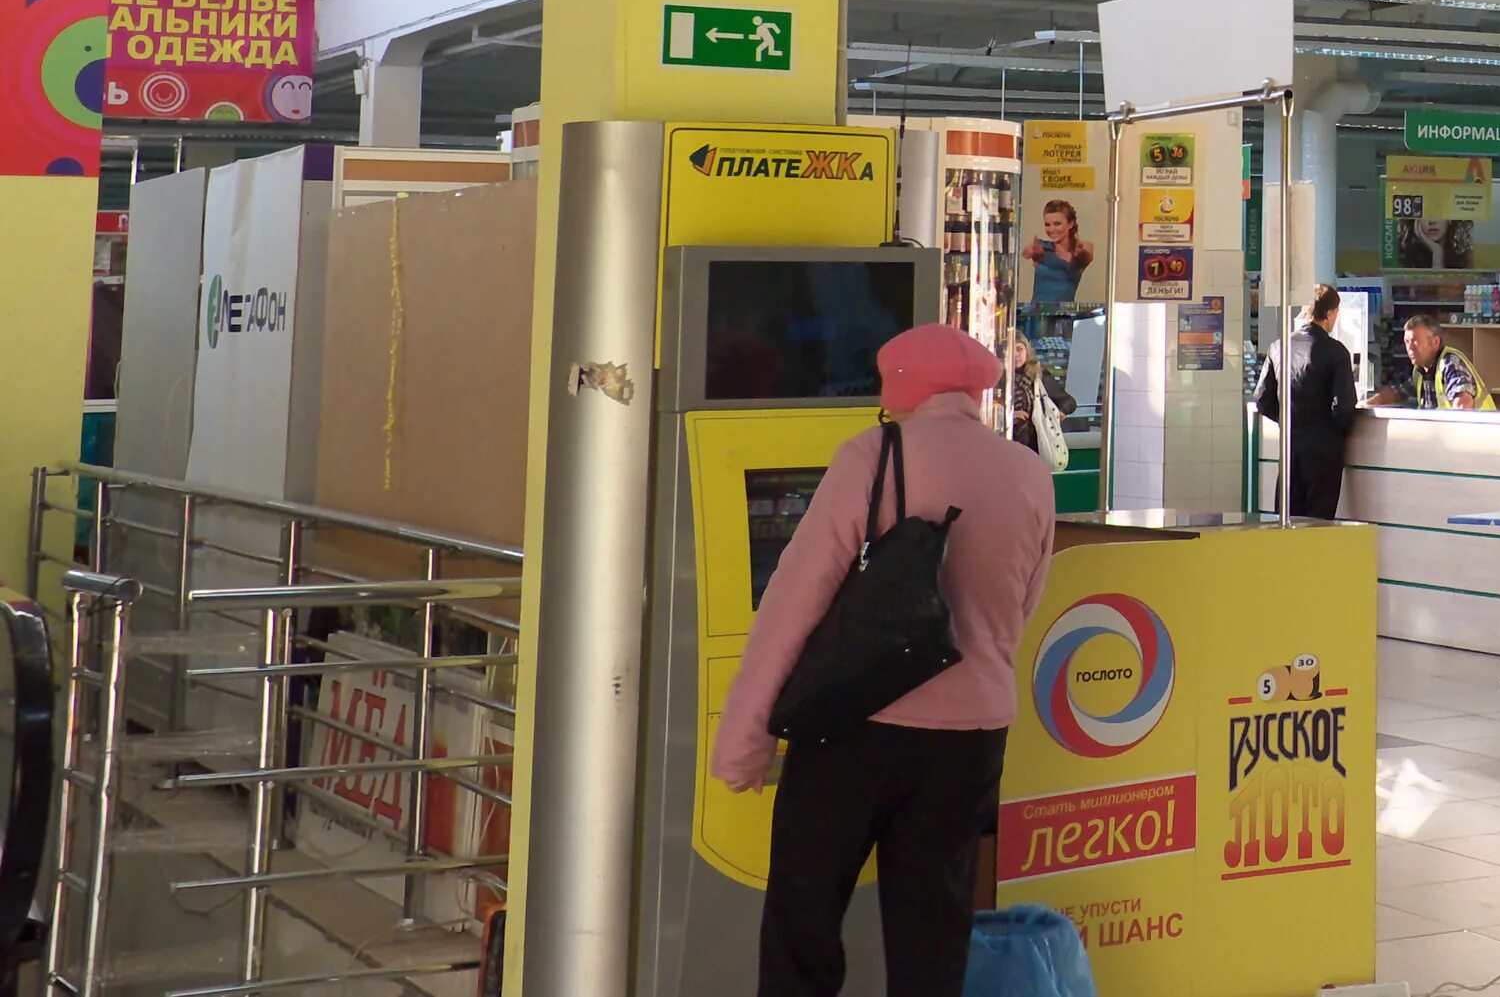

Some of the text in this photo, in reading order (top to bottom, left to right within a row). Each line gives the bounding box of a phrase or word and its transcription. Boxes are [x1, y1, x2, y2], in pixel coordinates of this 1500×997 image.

[127, 34, 298, 70] ОДЕЖДА
[1403, 164, 1436, 176] АКЦИЯ
[1394, 198, 1412, 216] 98
[1262, 657, 1315, 695] 5 30
[1227, 706, 1347, 792] РУССКОЕ
[1023, 783, 1175, 821] Стать миллионером
[1223, 764, 1346, 869] ЛОТО
[1079, 898, 1142, 920] УПУСТИ
[1098, 913, 1184, 947] ШАНС
